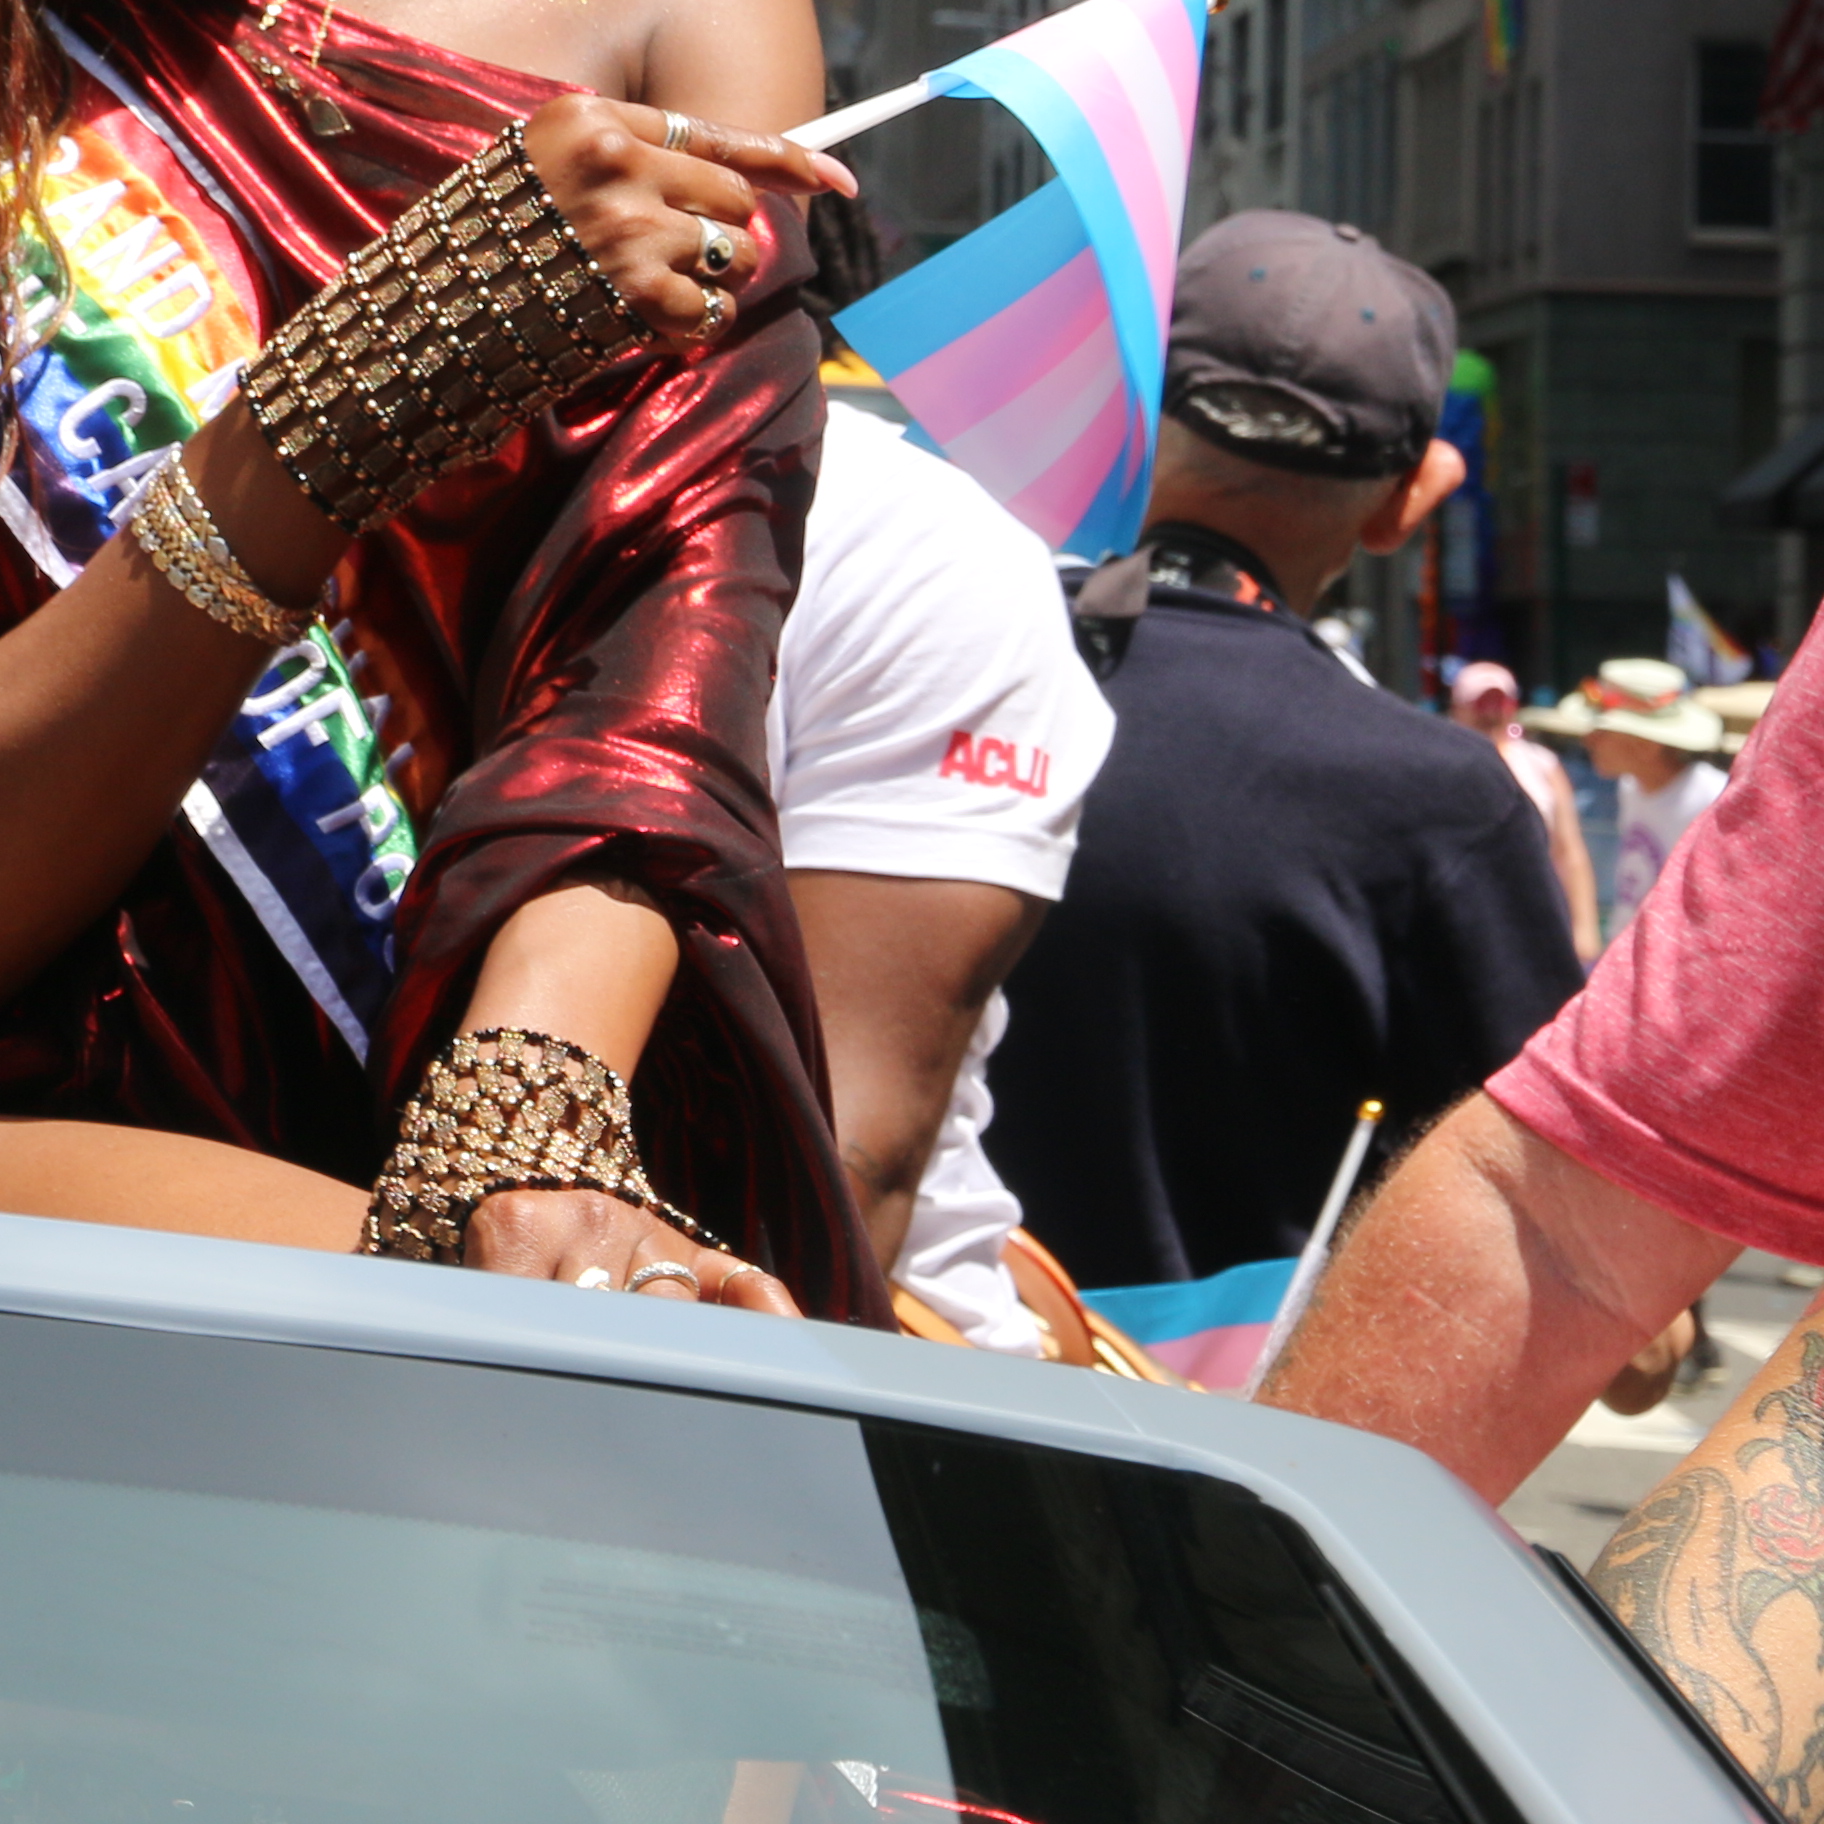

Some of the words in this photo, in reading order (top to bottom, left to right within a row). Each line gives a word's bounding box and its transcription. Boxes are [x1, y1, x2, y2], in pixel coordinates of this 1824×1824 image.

[240, 638, 367, 751] OF
[315, 782, 418, 973] PO
[938, 728, 1051, 798] ACLU
